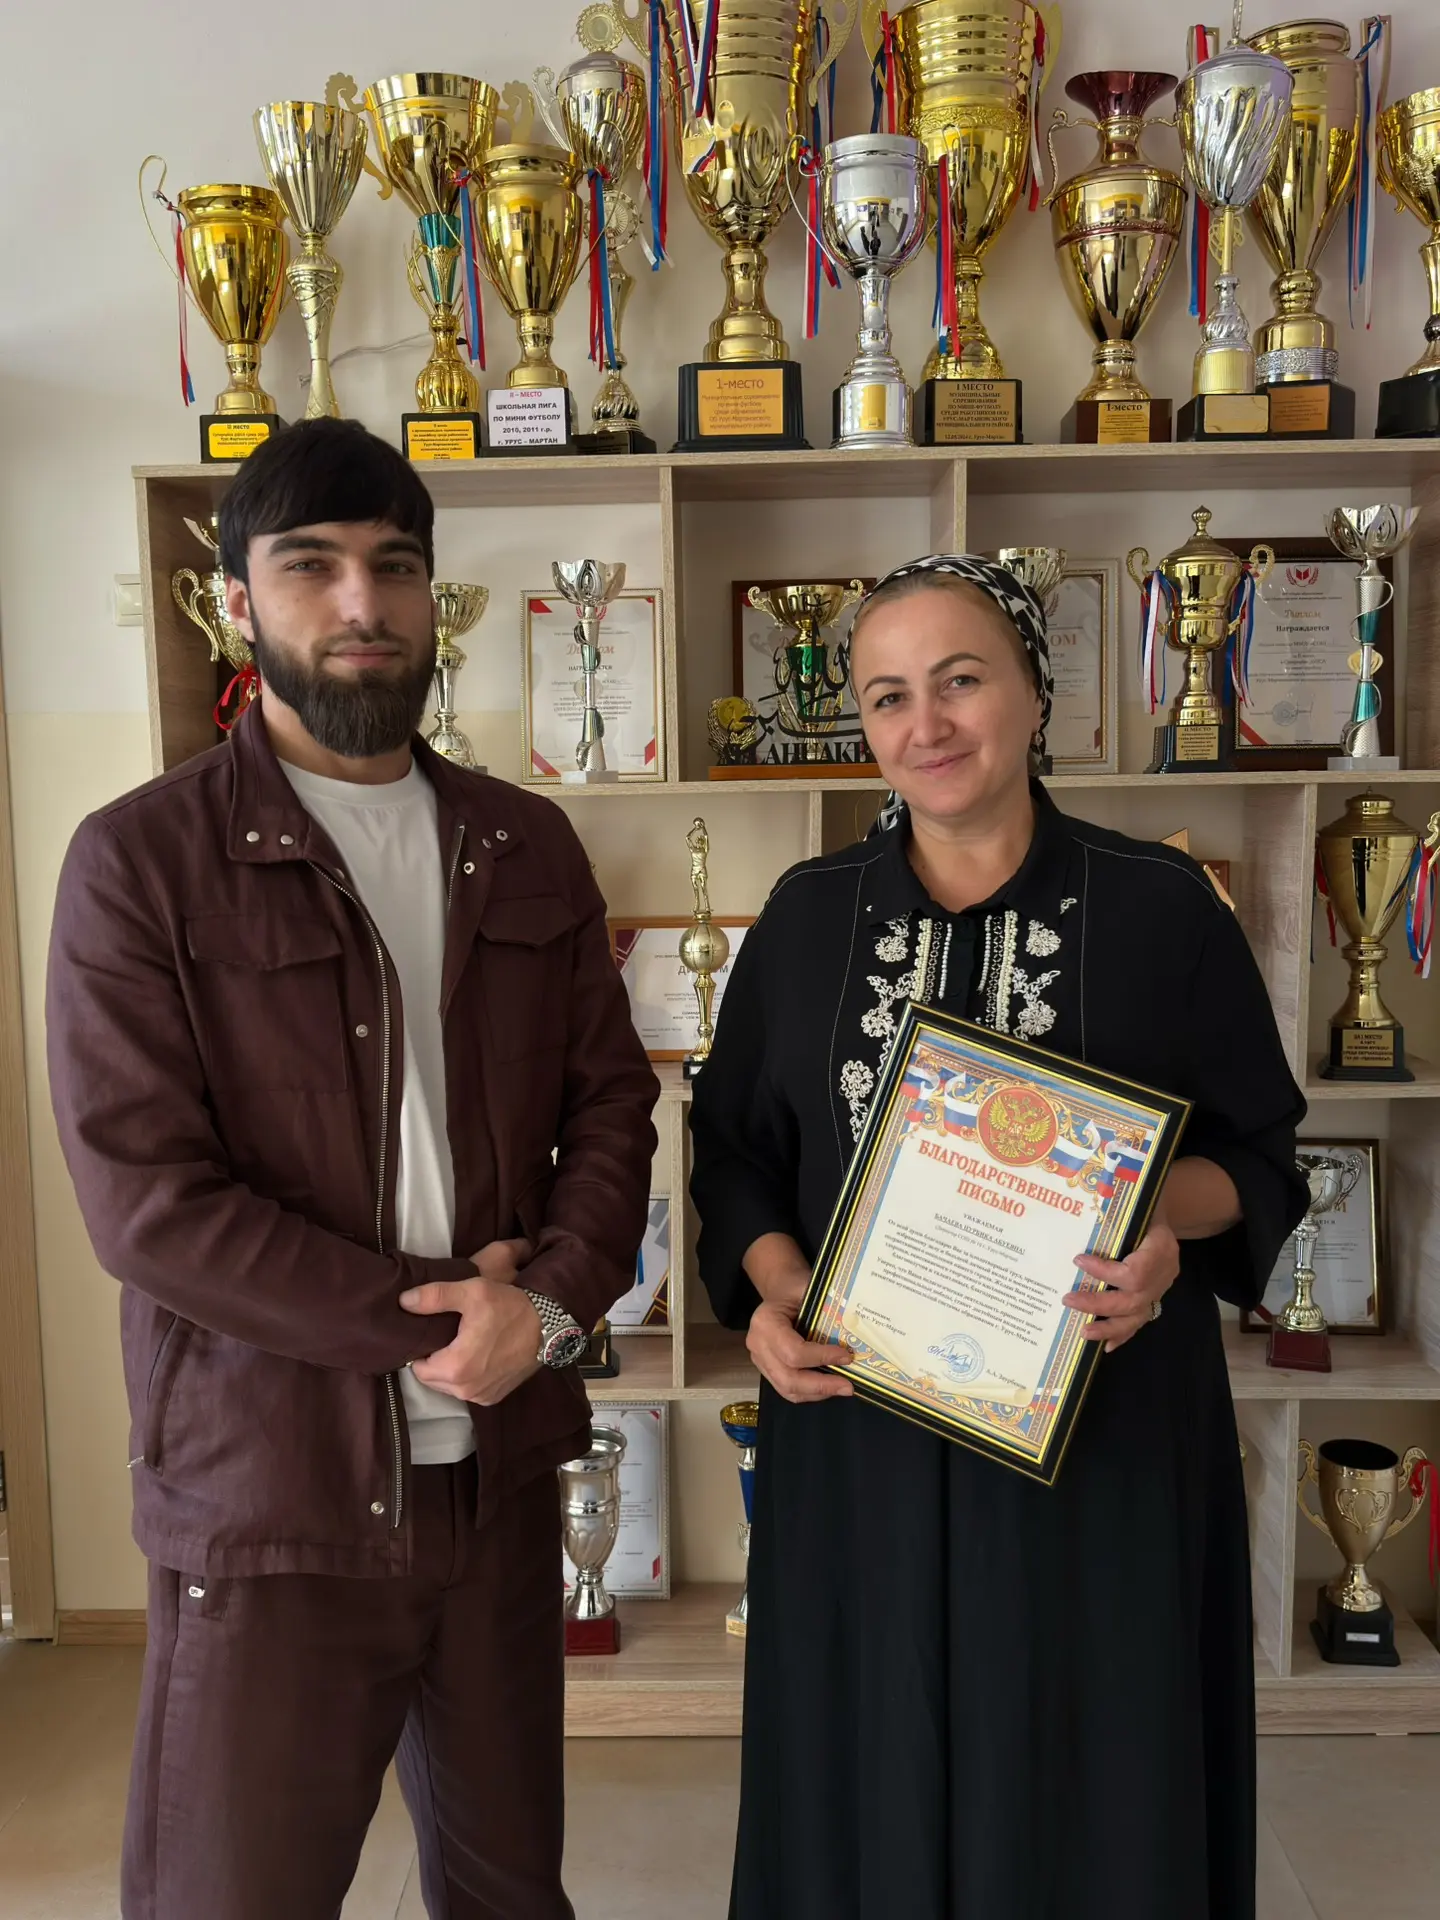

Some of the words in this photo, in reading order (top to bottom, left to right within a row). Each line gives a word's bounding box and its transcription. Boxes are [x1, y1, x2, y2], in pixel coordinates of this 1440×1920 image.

[716, 378, 764, 389] 1-место
[962, 383, 994, 391] МЕСТО
[1276, 625, 1330, 633] Награждается
[919, 1140, 1084, 1217] БЛАГОДАРСТВЕННОЕ
[957, 1180, 1026, 1218] ПИСЬМО
